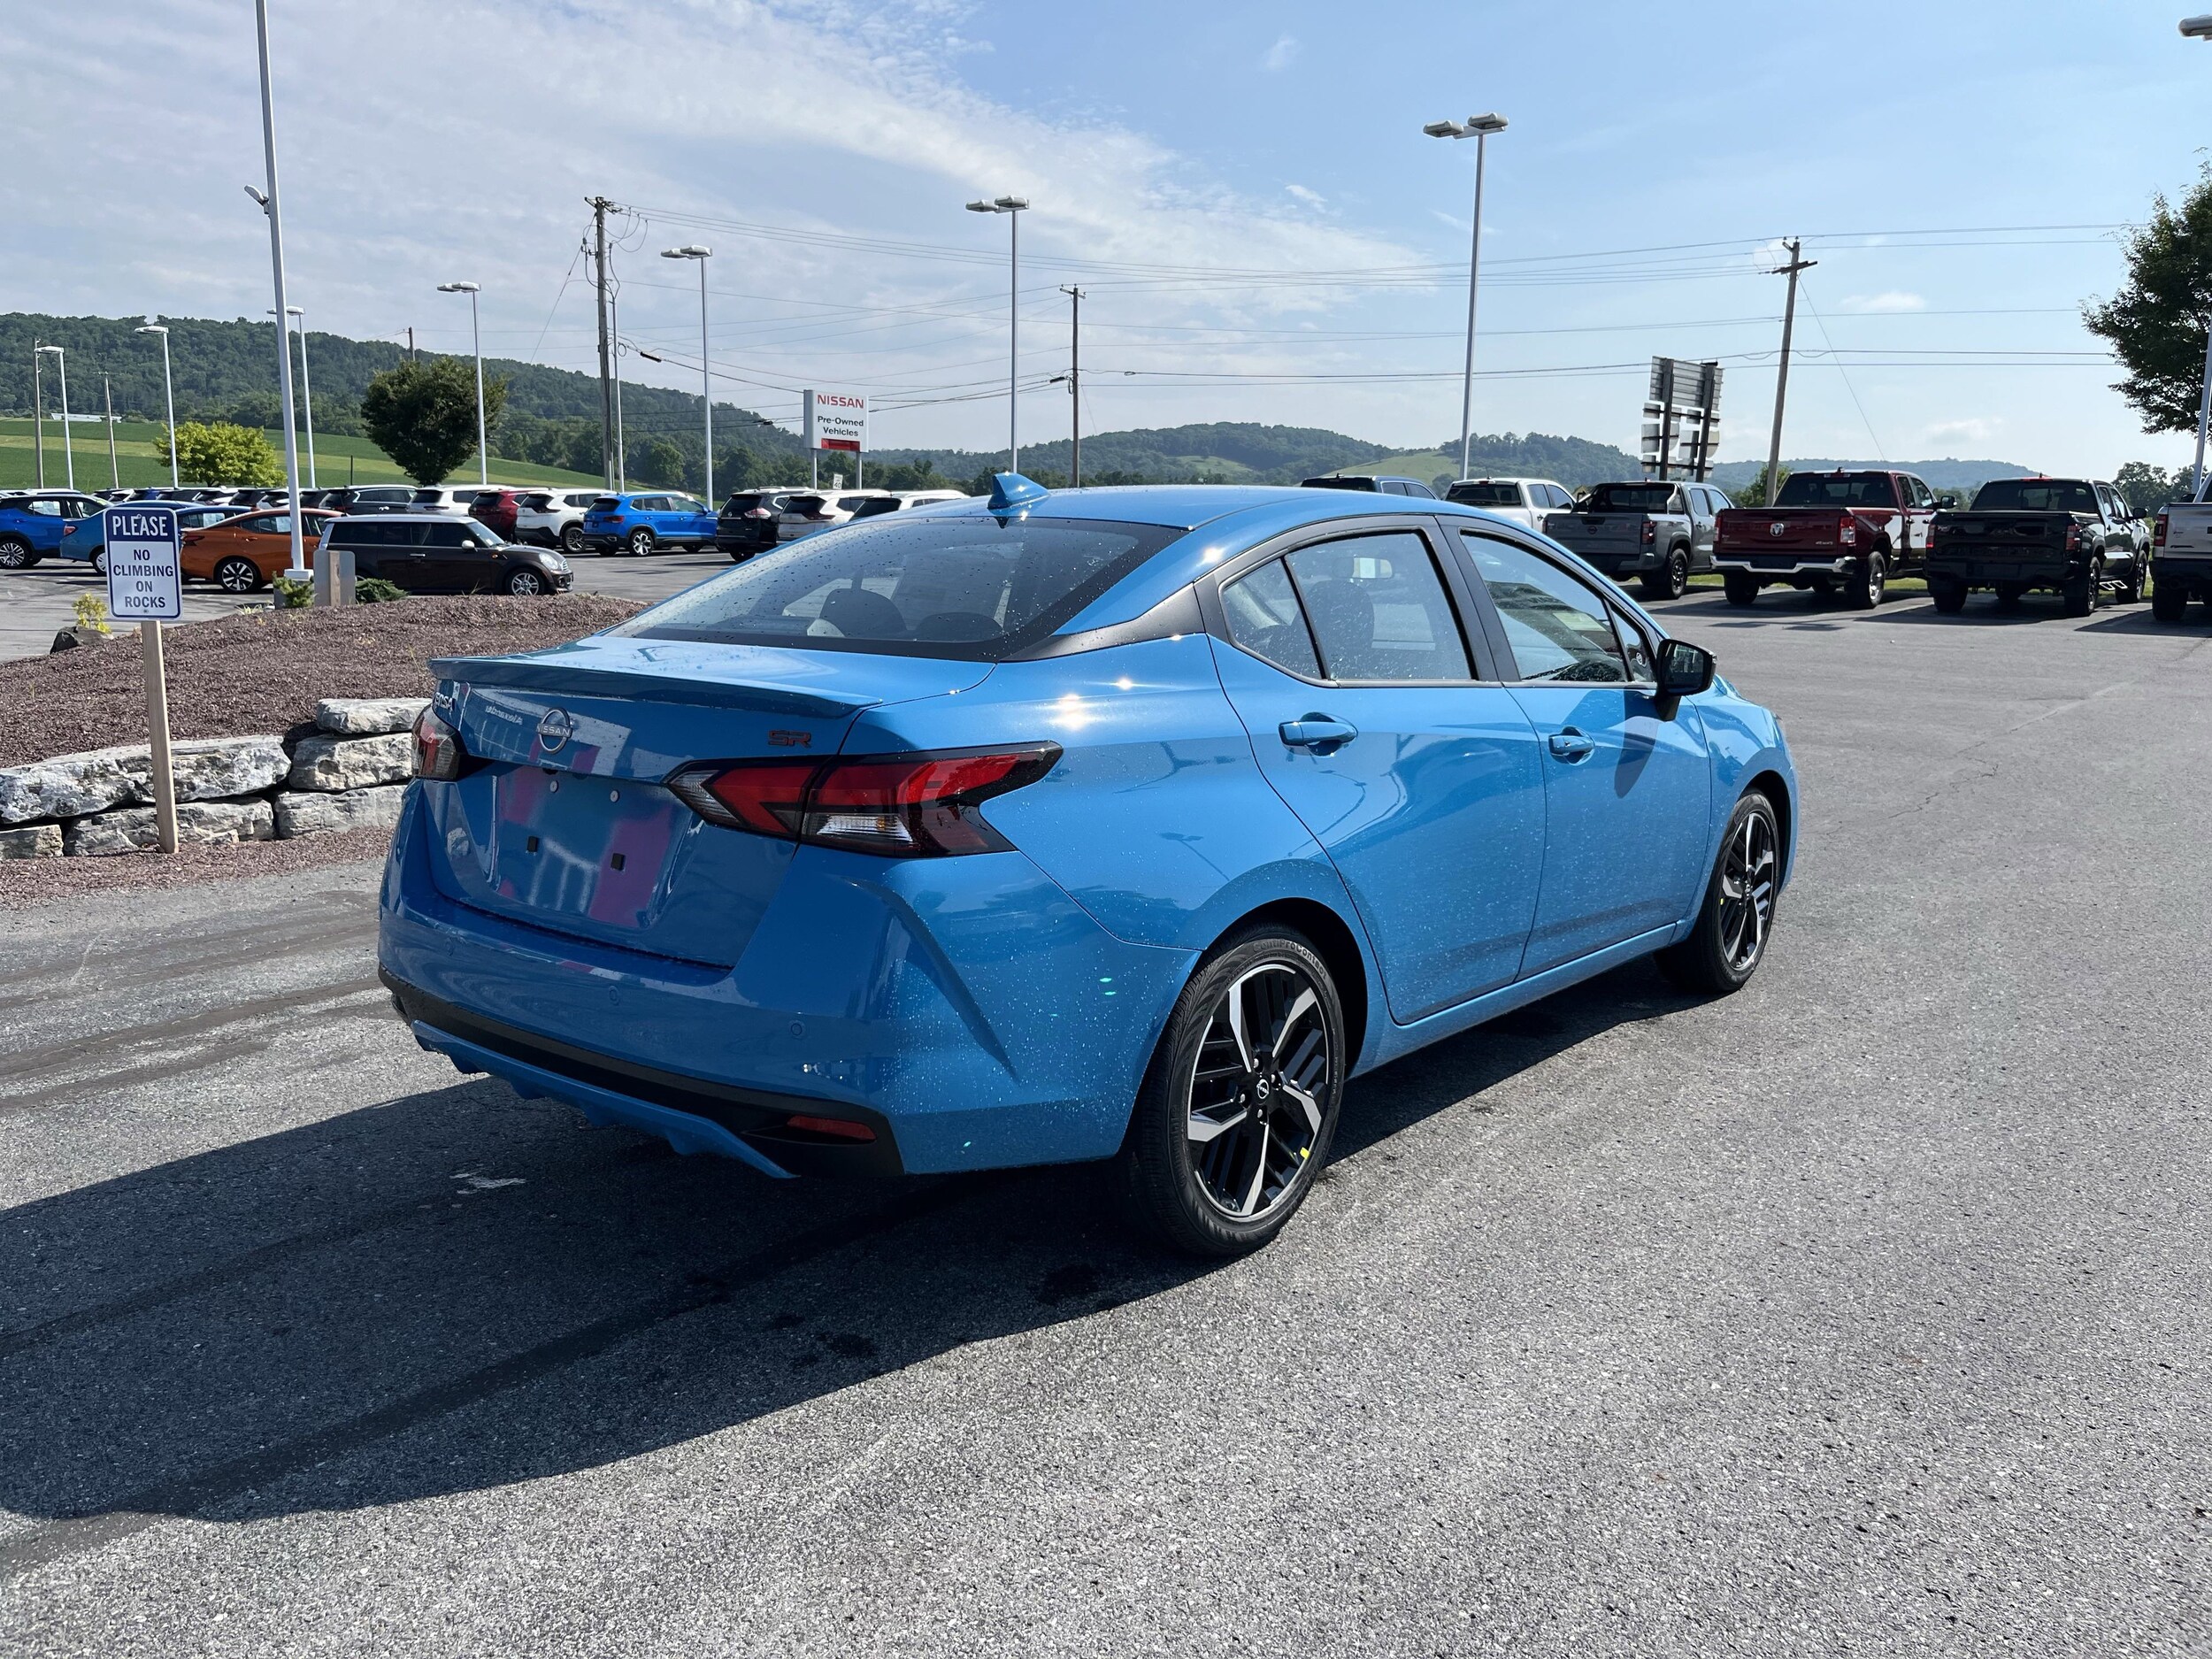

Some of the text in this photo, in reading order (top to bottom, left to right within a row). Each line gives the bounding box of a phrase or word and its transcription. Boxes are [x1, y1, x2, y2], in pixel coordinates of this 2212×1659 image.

[817, 395, 864, 408] NISSAN
[817, 415, 864, 426] Pre-Owned
[823, 426, 859, 437] Vehicles
[112, 515, 168, 536] PLEASE
[134, 549, 150, 561] NO
[113, 565, 173, 577] CLIMBING
[135, 580, 153, 592] ON
[125, 595, 165, 608] ROCKS
[536, 724, 572, 736] NISSAN
[768, 730, 812, 748] SR
